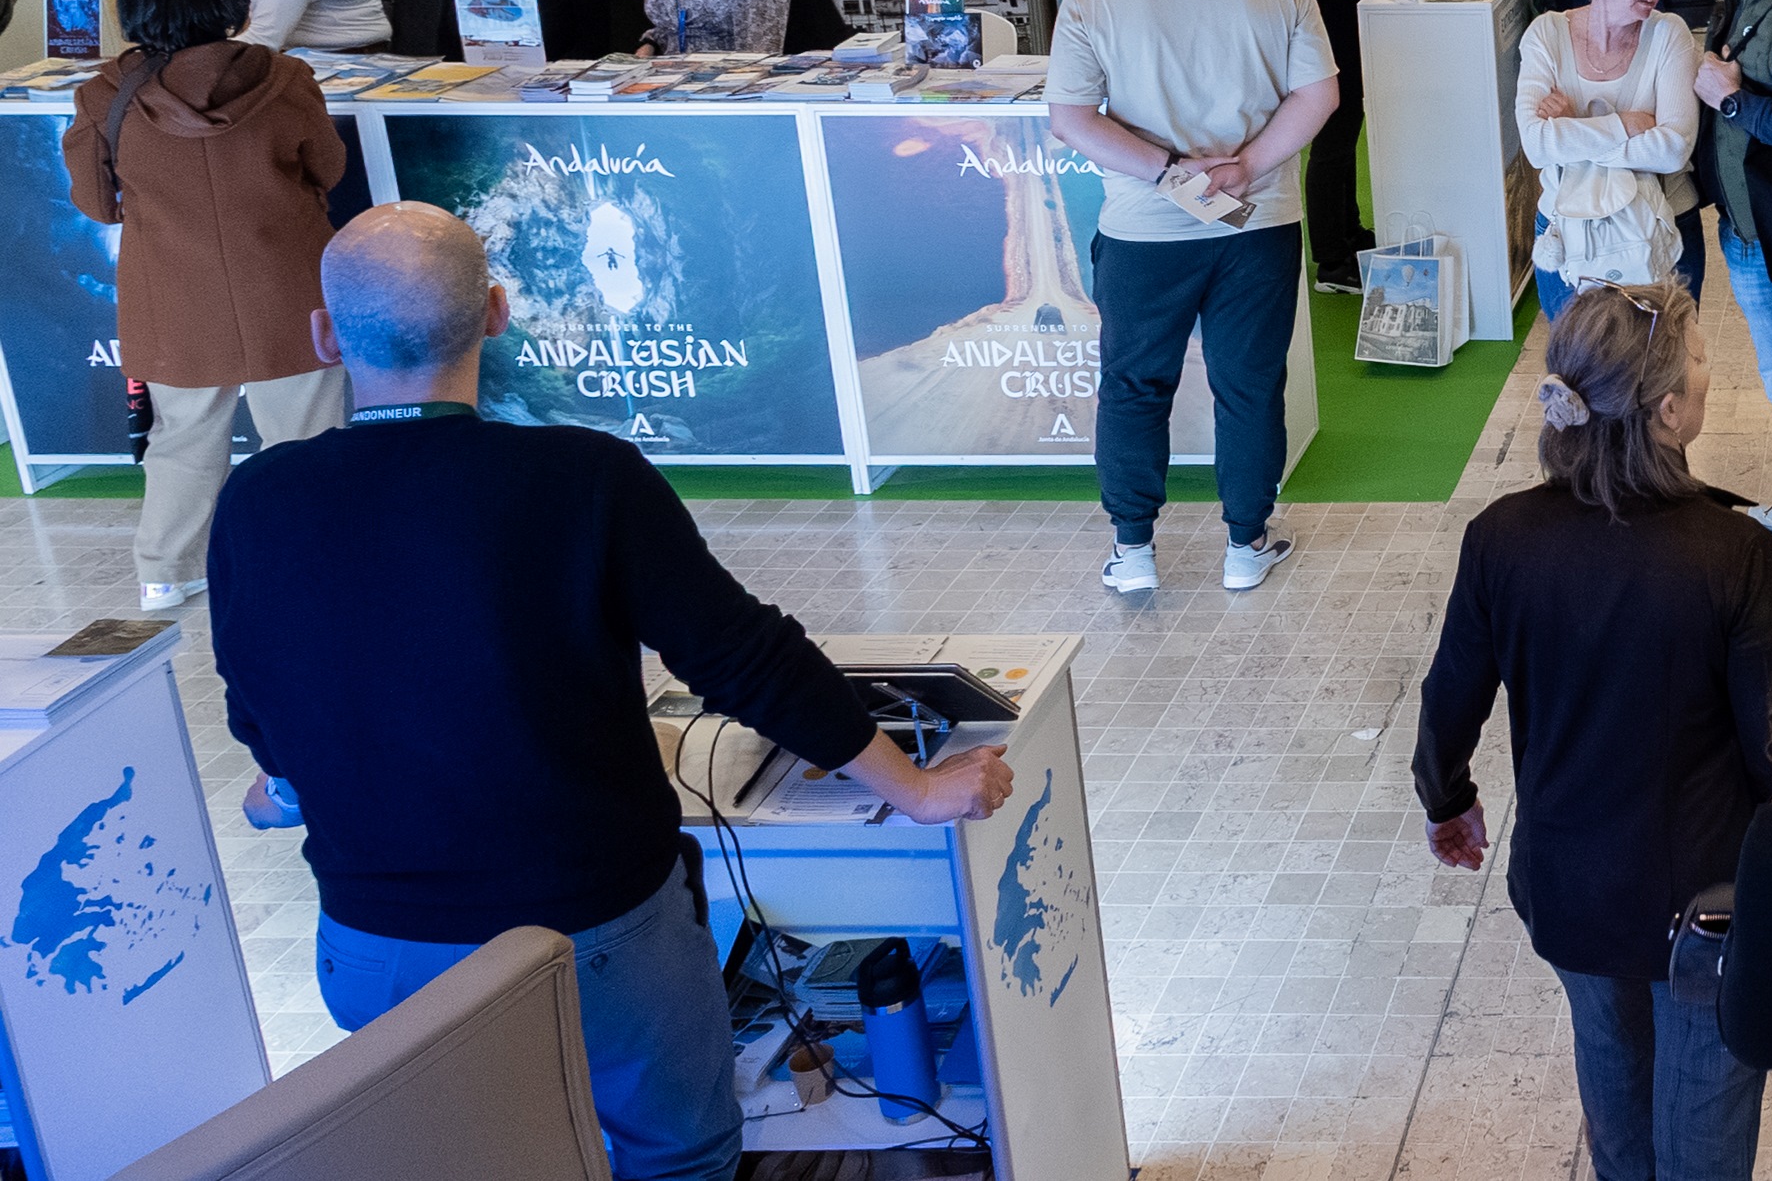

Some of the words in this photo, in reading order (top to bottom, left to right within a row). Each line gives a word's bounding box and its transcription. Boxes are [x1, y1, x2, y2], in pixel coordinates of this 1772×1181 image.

[523, 142, 676, 178] Andalucía
[956, 143, 1106, 179] Andalucía
[646, 323, 663, 333] TO
[668, 323, 694, 333] THE
[986, 324, 1065, 334] SURRENDER
[1072, 324, 1088, 333] TO
[939, 339, 1101, 368] ANDALUS
[576, 370, 697, 398] CRUSH
